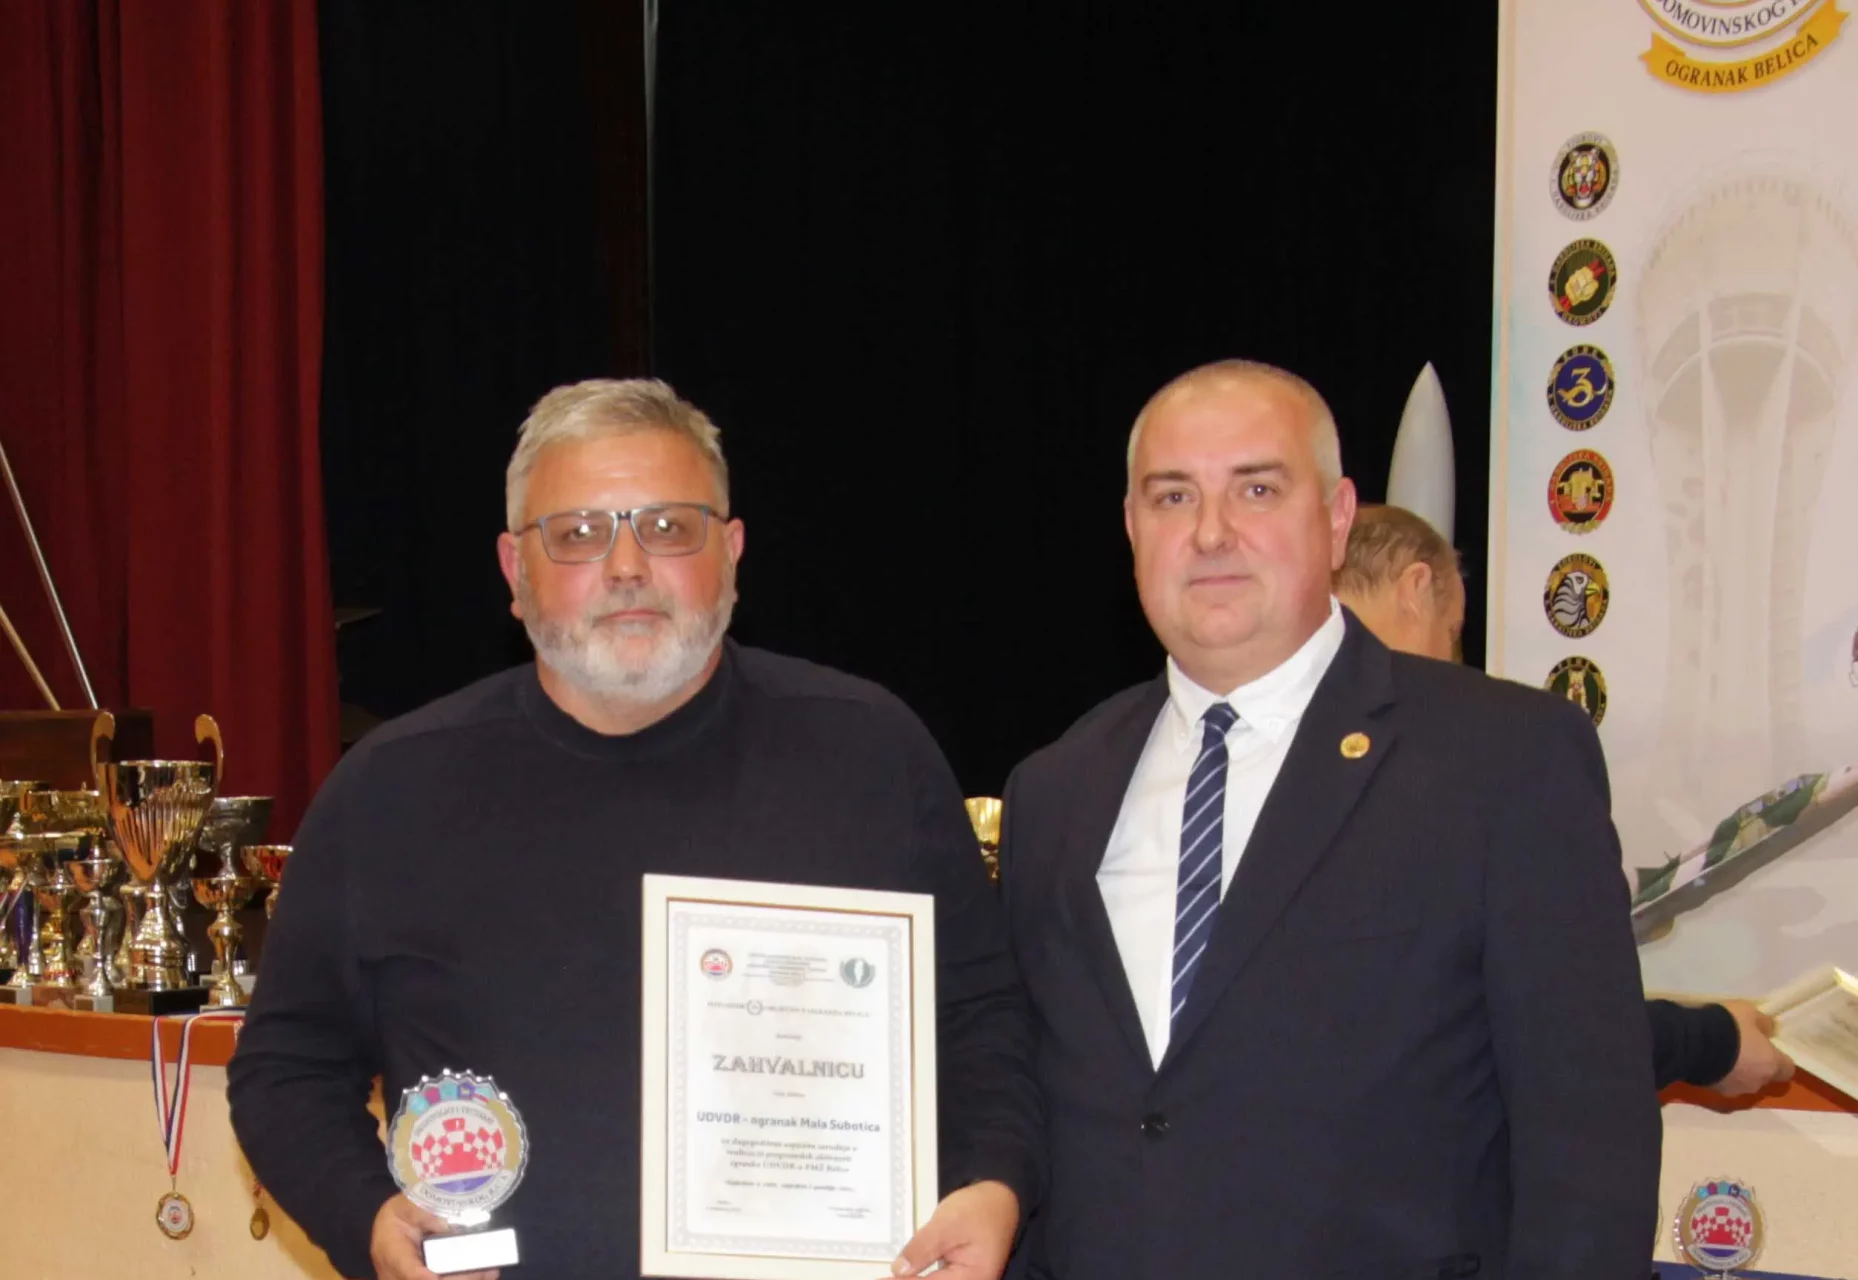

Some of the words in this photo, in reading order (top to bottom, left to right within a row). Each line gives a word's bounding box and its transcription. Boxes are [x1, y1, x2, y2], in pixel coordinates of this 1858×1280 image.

[1657, 0, 1785, 36] OMOVINSKOG
[1665, 59, 1748, 87] OGRANAK
[1753, 33, 1818, 80] BELICA
[712, 1053, 865, 1080] ZAHVALNICU
[697, 1110, 741, 1124] UDVDR
[750, 1115, 798, 1129] ogranak
[800, 1117, 828, 1131] Mala
[829, 1118, 881, 1133] Subotica
